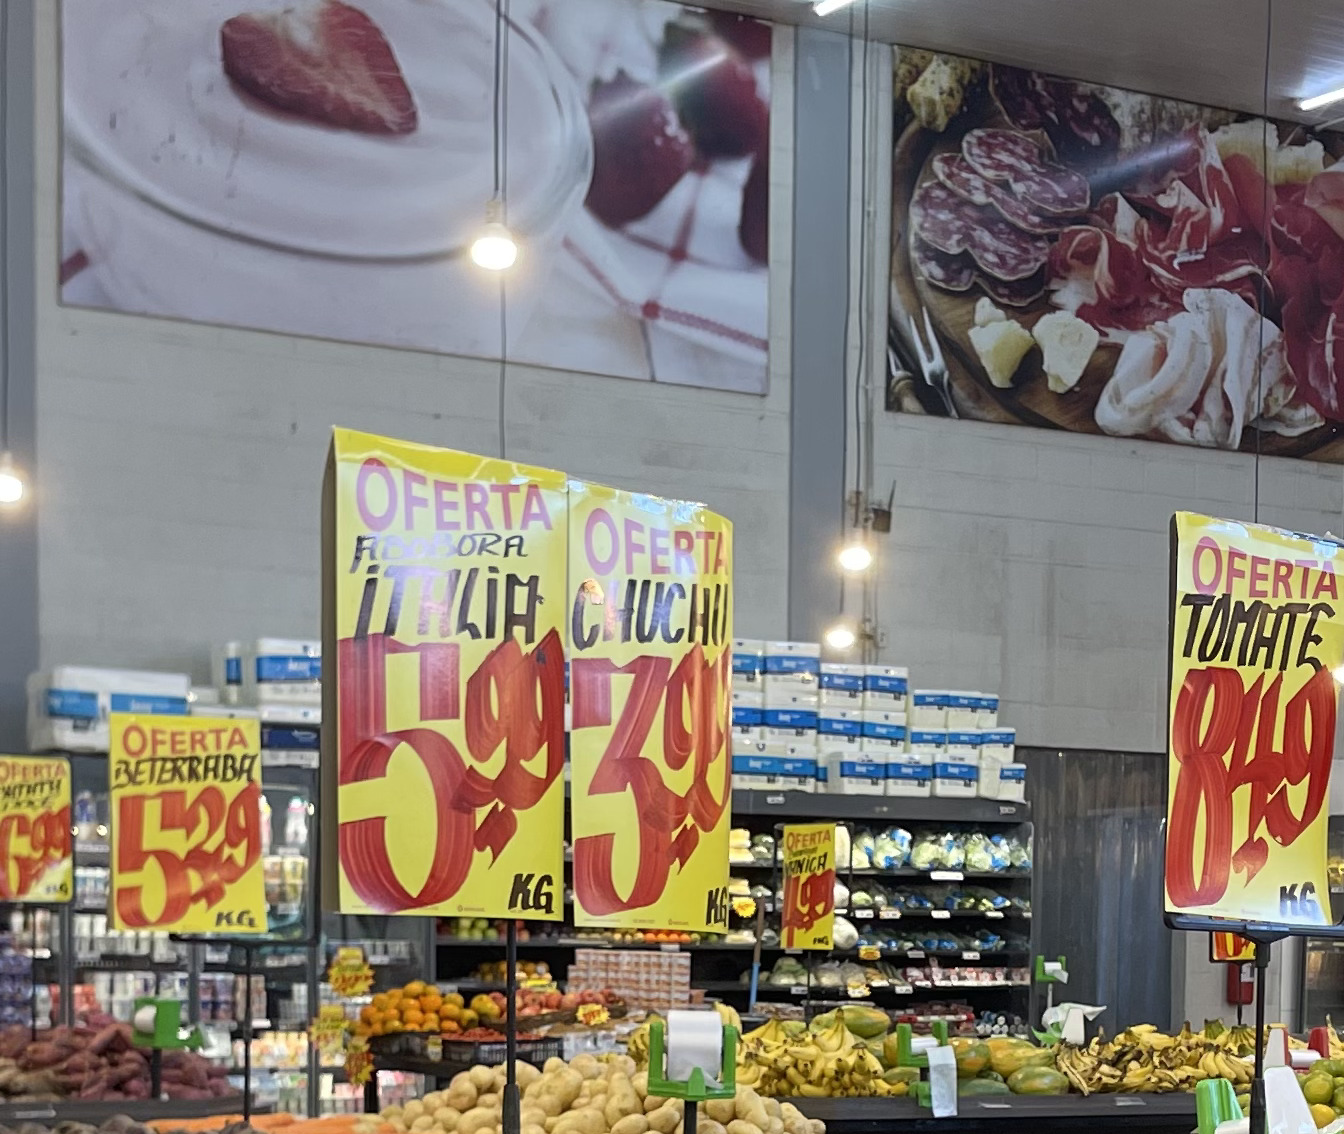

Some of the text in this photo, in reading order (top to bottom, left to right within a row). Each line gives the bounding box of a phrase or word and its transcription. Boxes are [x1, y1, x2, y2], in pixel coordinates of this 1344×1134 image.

[356, 457, 552, 532] OFERTA
[585, 507, 729, 577] OFERTA
[1192, 535, 1339, 600] OFERTA
[572, 577, 728, 651] CHUCHU
[1180, 593, 1336, 672] TOMATE
[122, 725, 249, 758] OFERTA
[112, 753, 258, 790] BETERRABA
[786, 829, 831, 850] OFERTA
[508, 872, 554, 914] KG
[705, 888, 729, 928] KG
[1279, 880, 1319, 919] KG
